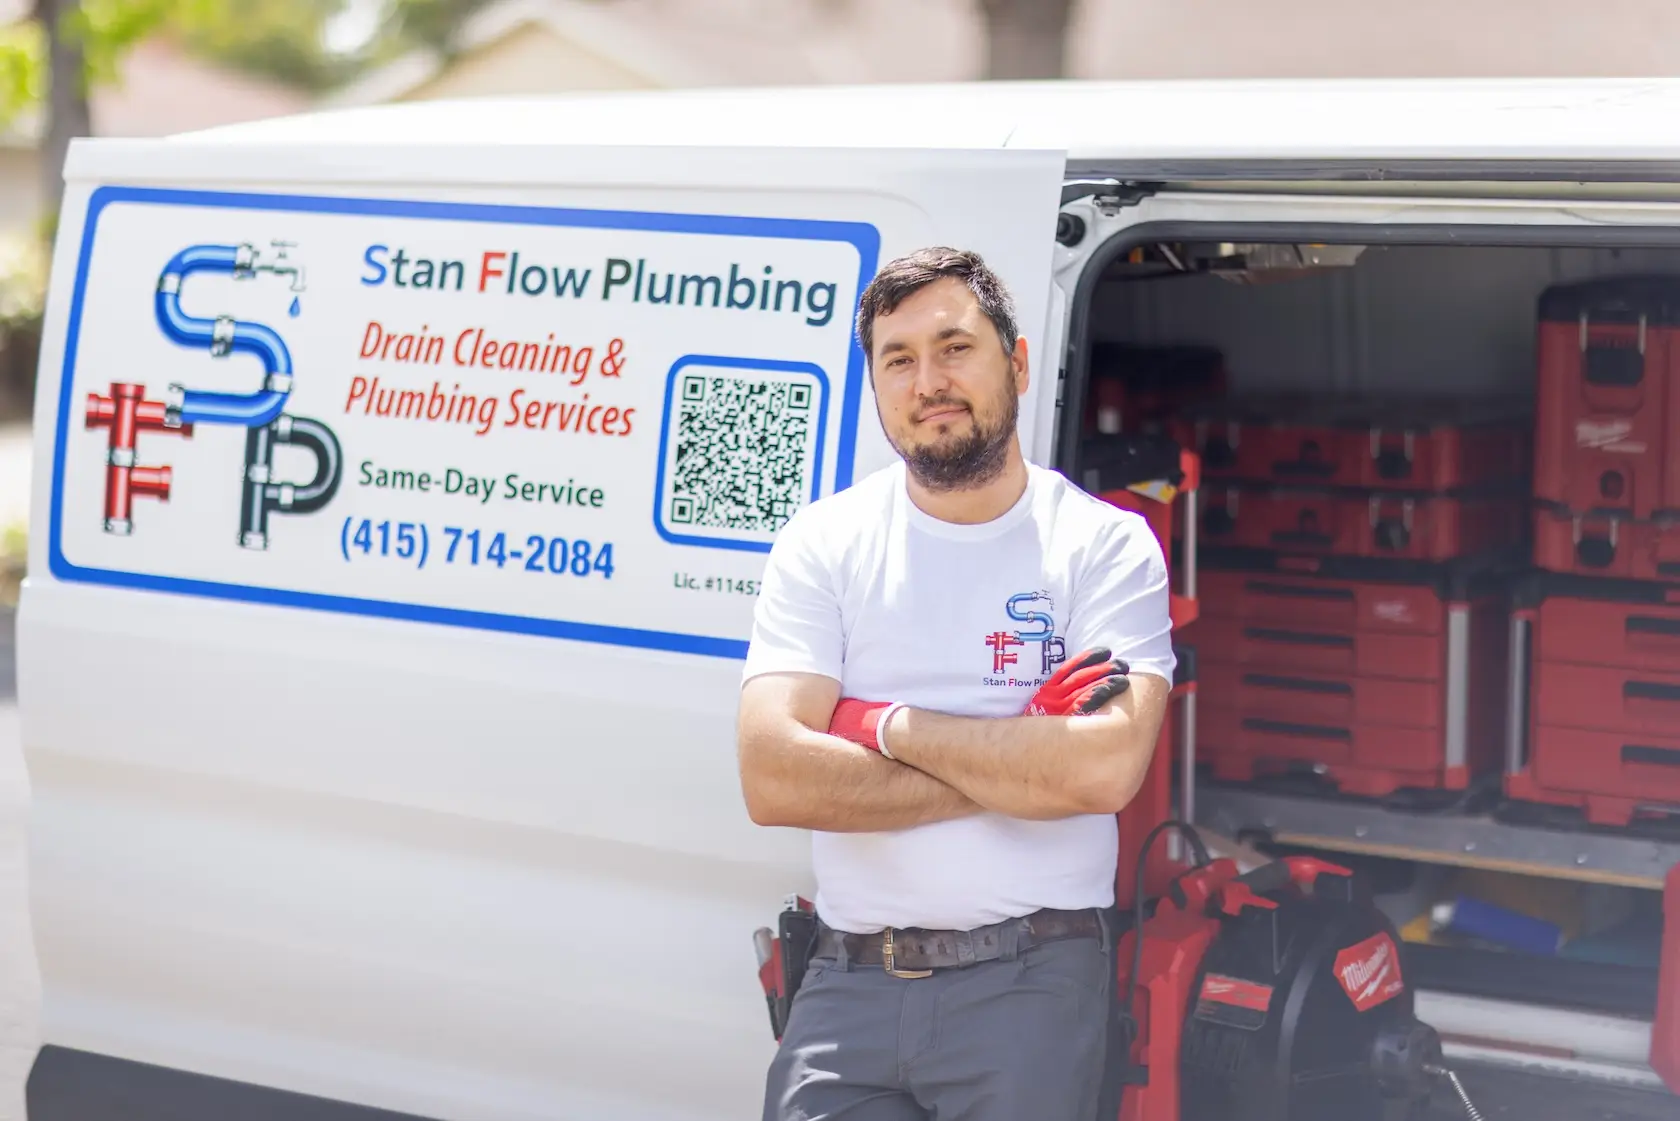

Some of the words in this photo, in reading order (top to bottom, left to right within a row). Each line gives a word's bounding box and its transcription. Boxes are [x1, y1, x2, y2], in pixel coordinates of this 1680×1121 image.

[360, 244, 465, 290] Stan
[478, 251, 592, 298] Flow
[601, 258, 838, 327] Plumbing
[359, 321, 445, 364] Drain
[453, 328, 594, 386] Cleaning
[600, 338, 627, 378] &
[345, 376, 499, 435] Plumbing
[504, 389, 636, 437] Services
[359, 461, 497, 504] Same-Day
[504, 474, 605, 507] Service
[340, 516, 429, 568] (415)
[444, 526, 615, 579] 714-2084
[674, 572, 700, 590] Lic.
[983, 677, 1006, 686] Stan
[1008, 678, 1032, 687] Flow
